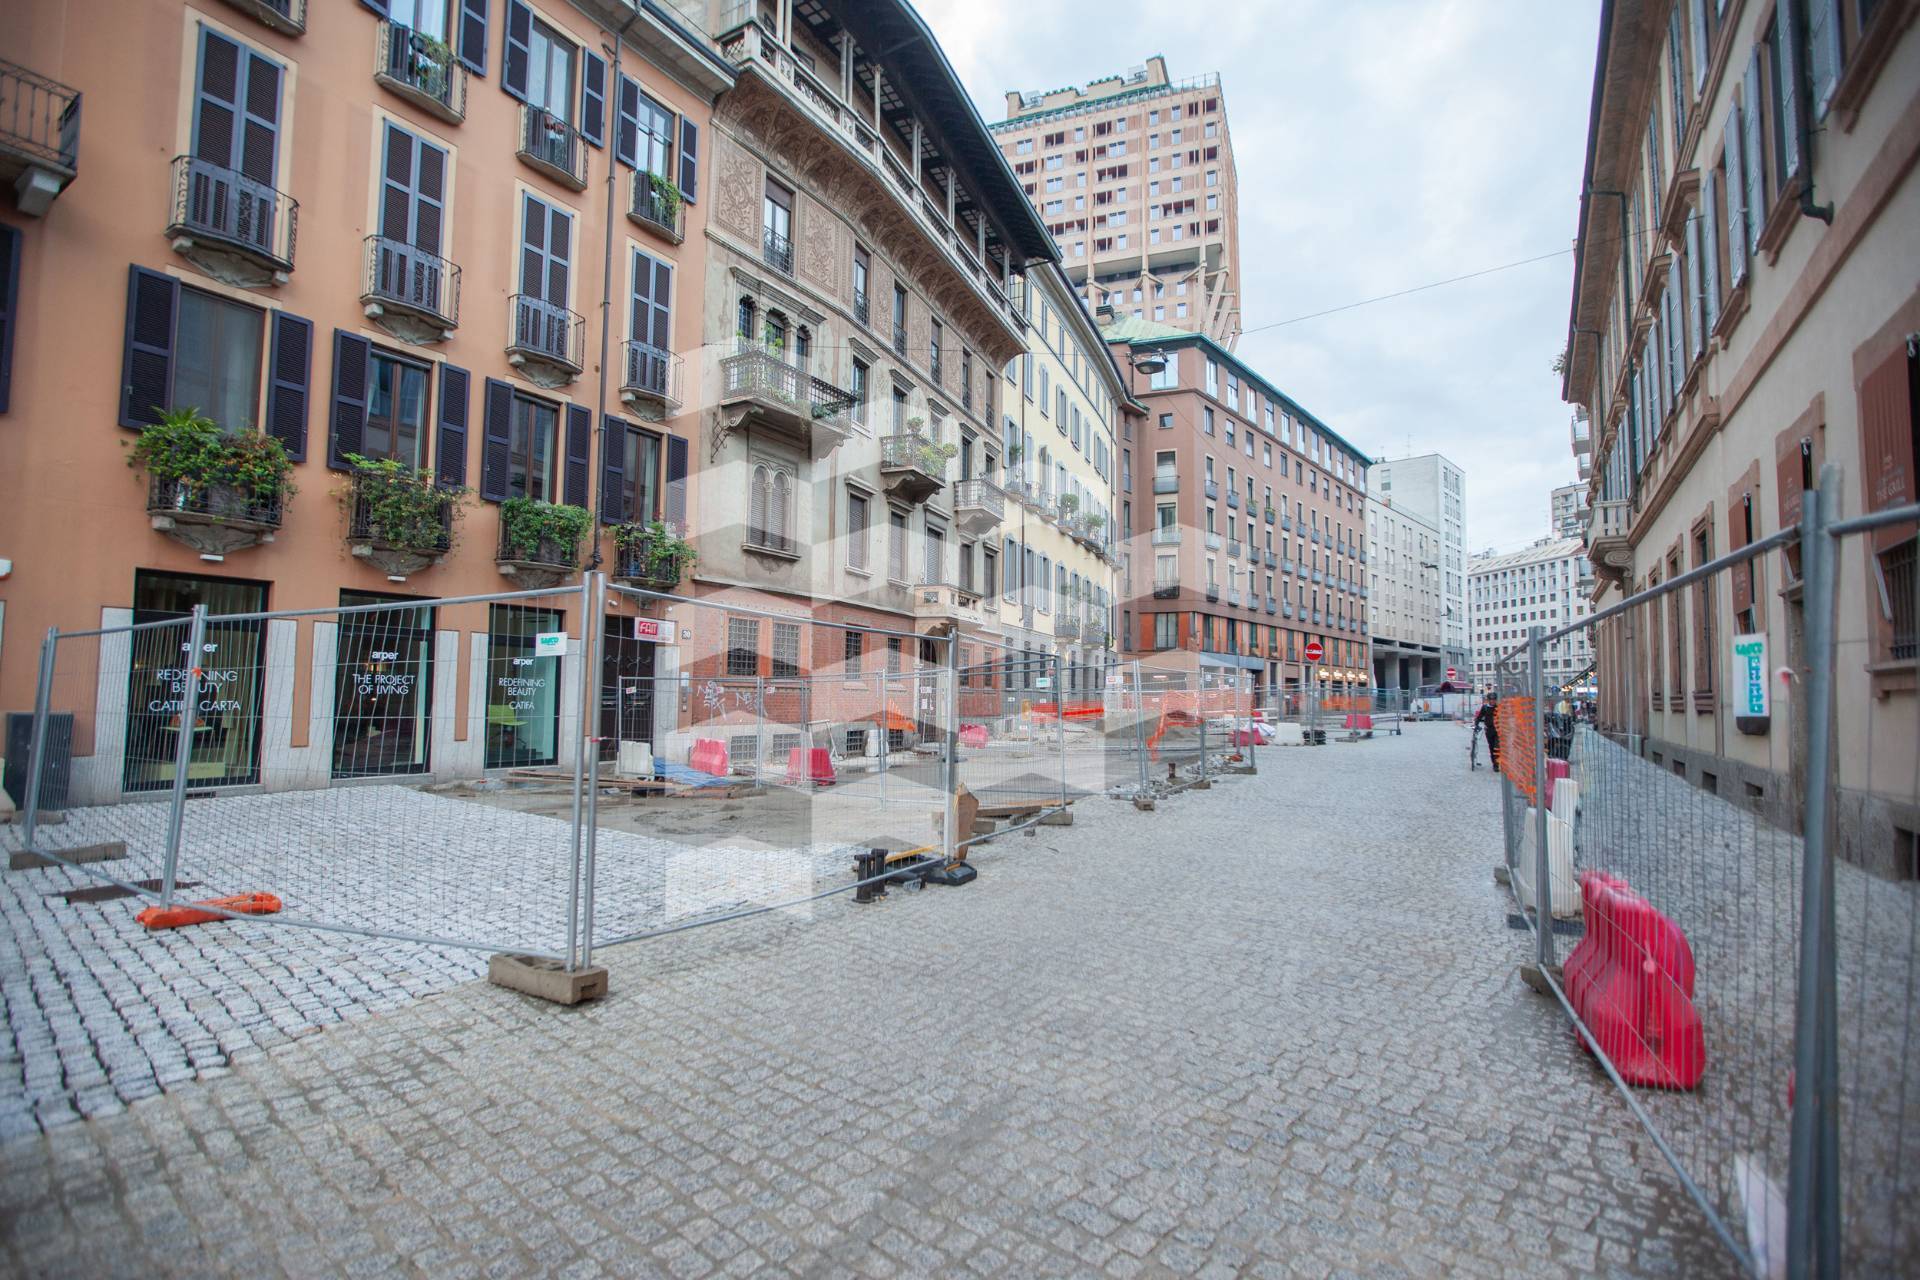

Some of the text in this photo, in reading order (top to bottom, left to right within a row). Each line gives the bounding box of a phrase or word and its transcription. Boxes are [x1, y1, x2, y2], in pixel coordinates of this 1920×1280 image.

[182, 643, 218, 653] aer
[372, 651, 399, 660] arper
[513, 658, 534, 667] arper
[157, 669, 238, 681] REDENING
[352, 674, 415, 686] THE PROJECT
[172, 682, 223, 693] BEUTY
[498, 678, 546, 687] REDEFINING
[358, 685, 409, 695] OF LIVING
[507, 687, 537, 696] BEAUTY
[200, 701, 240, 711] CARTA
[509, 701, 535, 710] CATIFA
